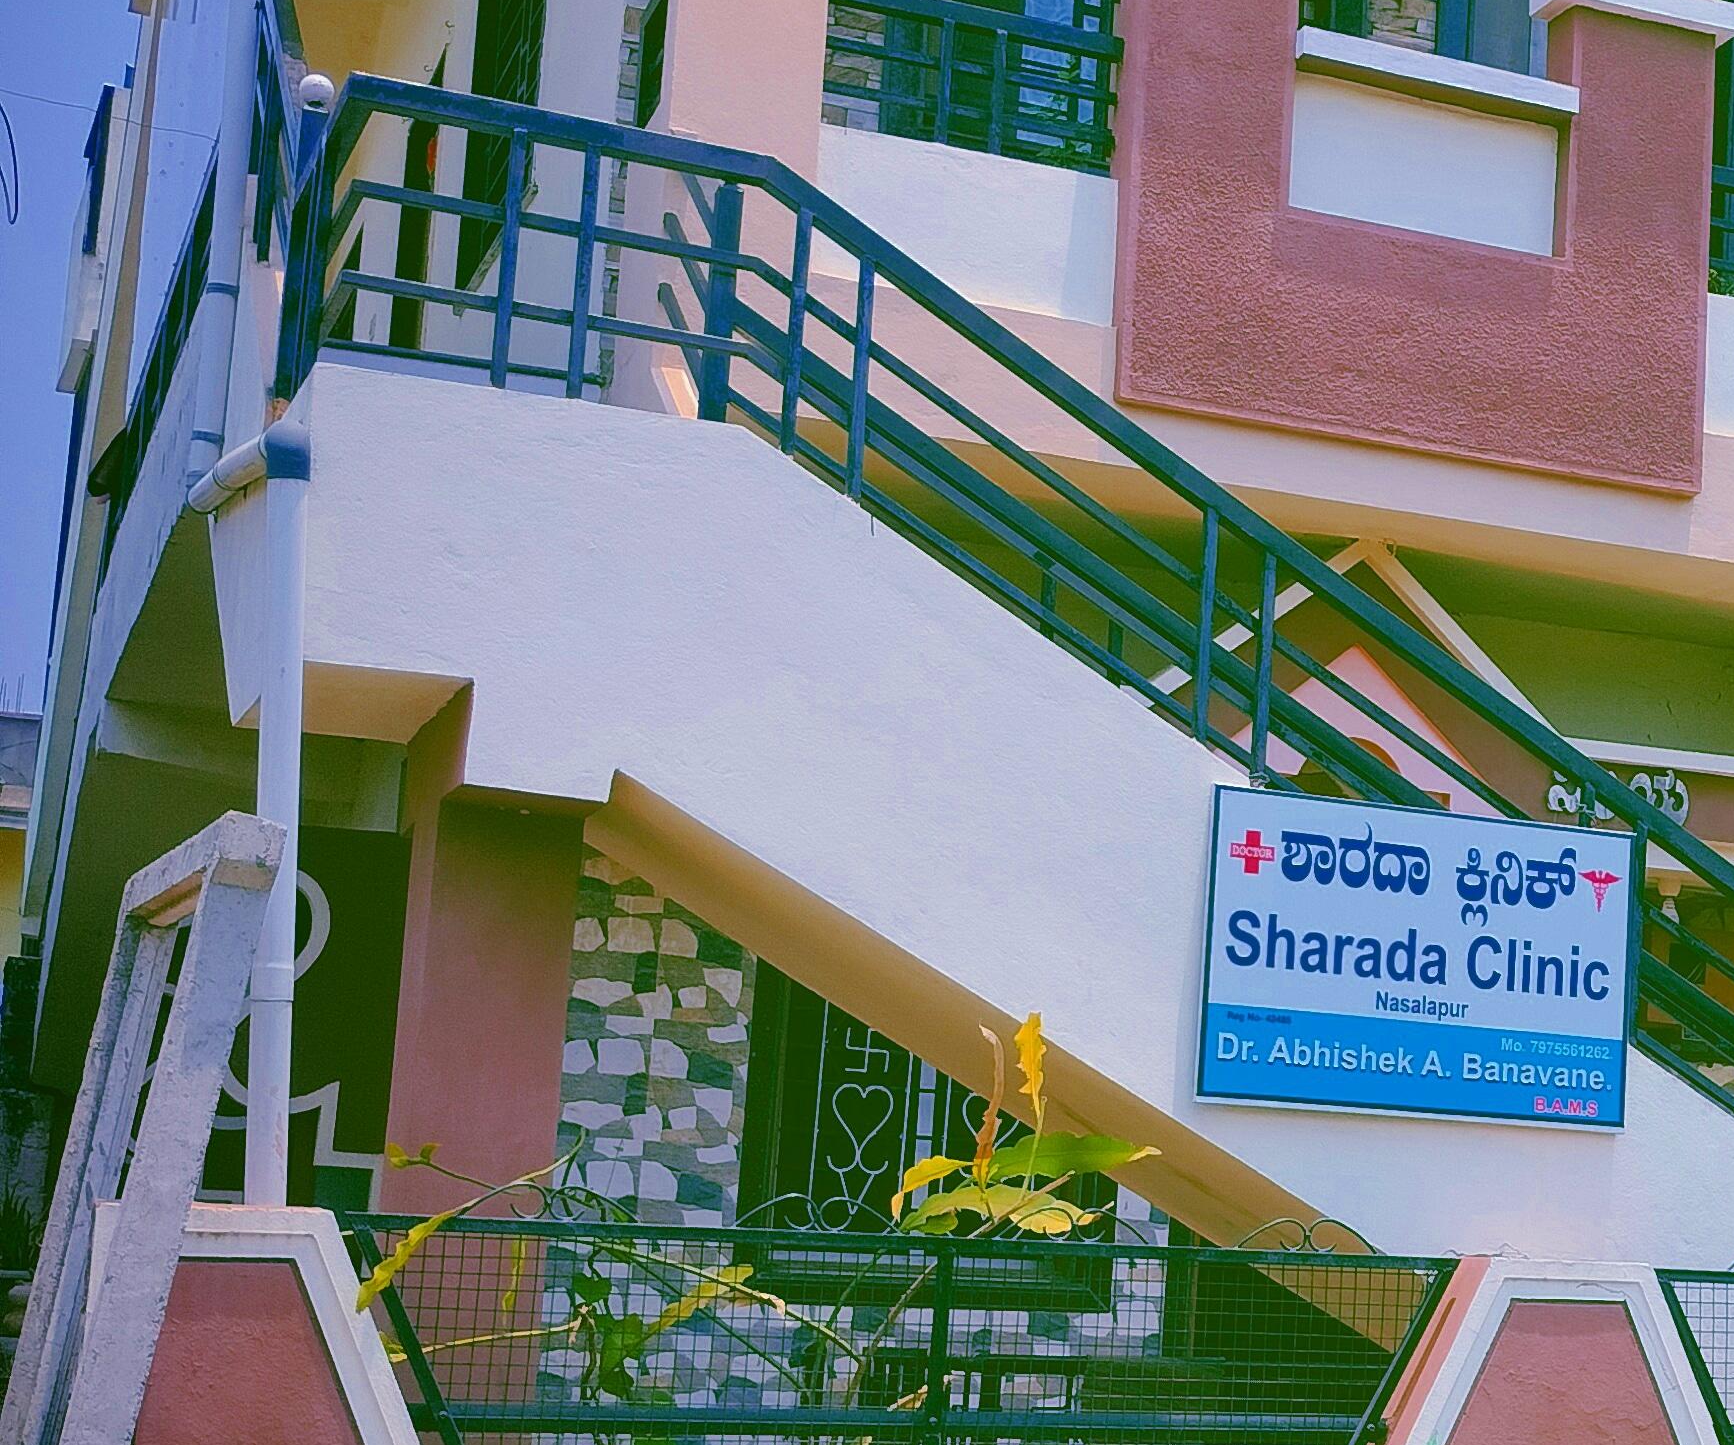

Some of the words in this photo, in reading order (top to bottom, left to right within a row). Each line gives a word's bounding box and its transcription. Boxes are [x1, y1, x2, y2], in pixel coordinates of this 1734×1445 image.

[1231, 844, 1273, 859] DOCTOR
[1281, 821, 1430, 895] ಶಾರದಾ
[1456, 847, 1577, 927] ಕ್ಲಿನಿಕ್
[1225, 910, 1447, 985] Sharada
[1467, 935, 1610, 1001] Clinic
[1375, 991, 1469, 1022] Nasalapur
[1501, 1037, 1526, 1053] Mo.
[1217, 1031, 1259, 1063] Dr.
[1267, 1036, 1415, 1075] Abhishek
[1420, 1049, 1452, 1078] A.
[1463, 1052, 1612, 1091] Banavane.
[1535, 1097, 1598, 1117] B.A.M.S
